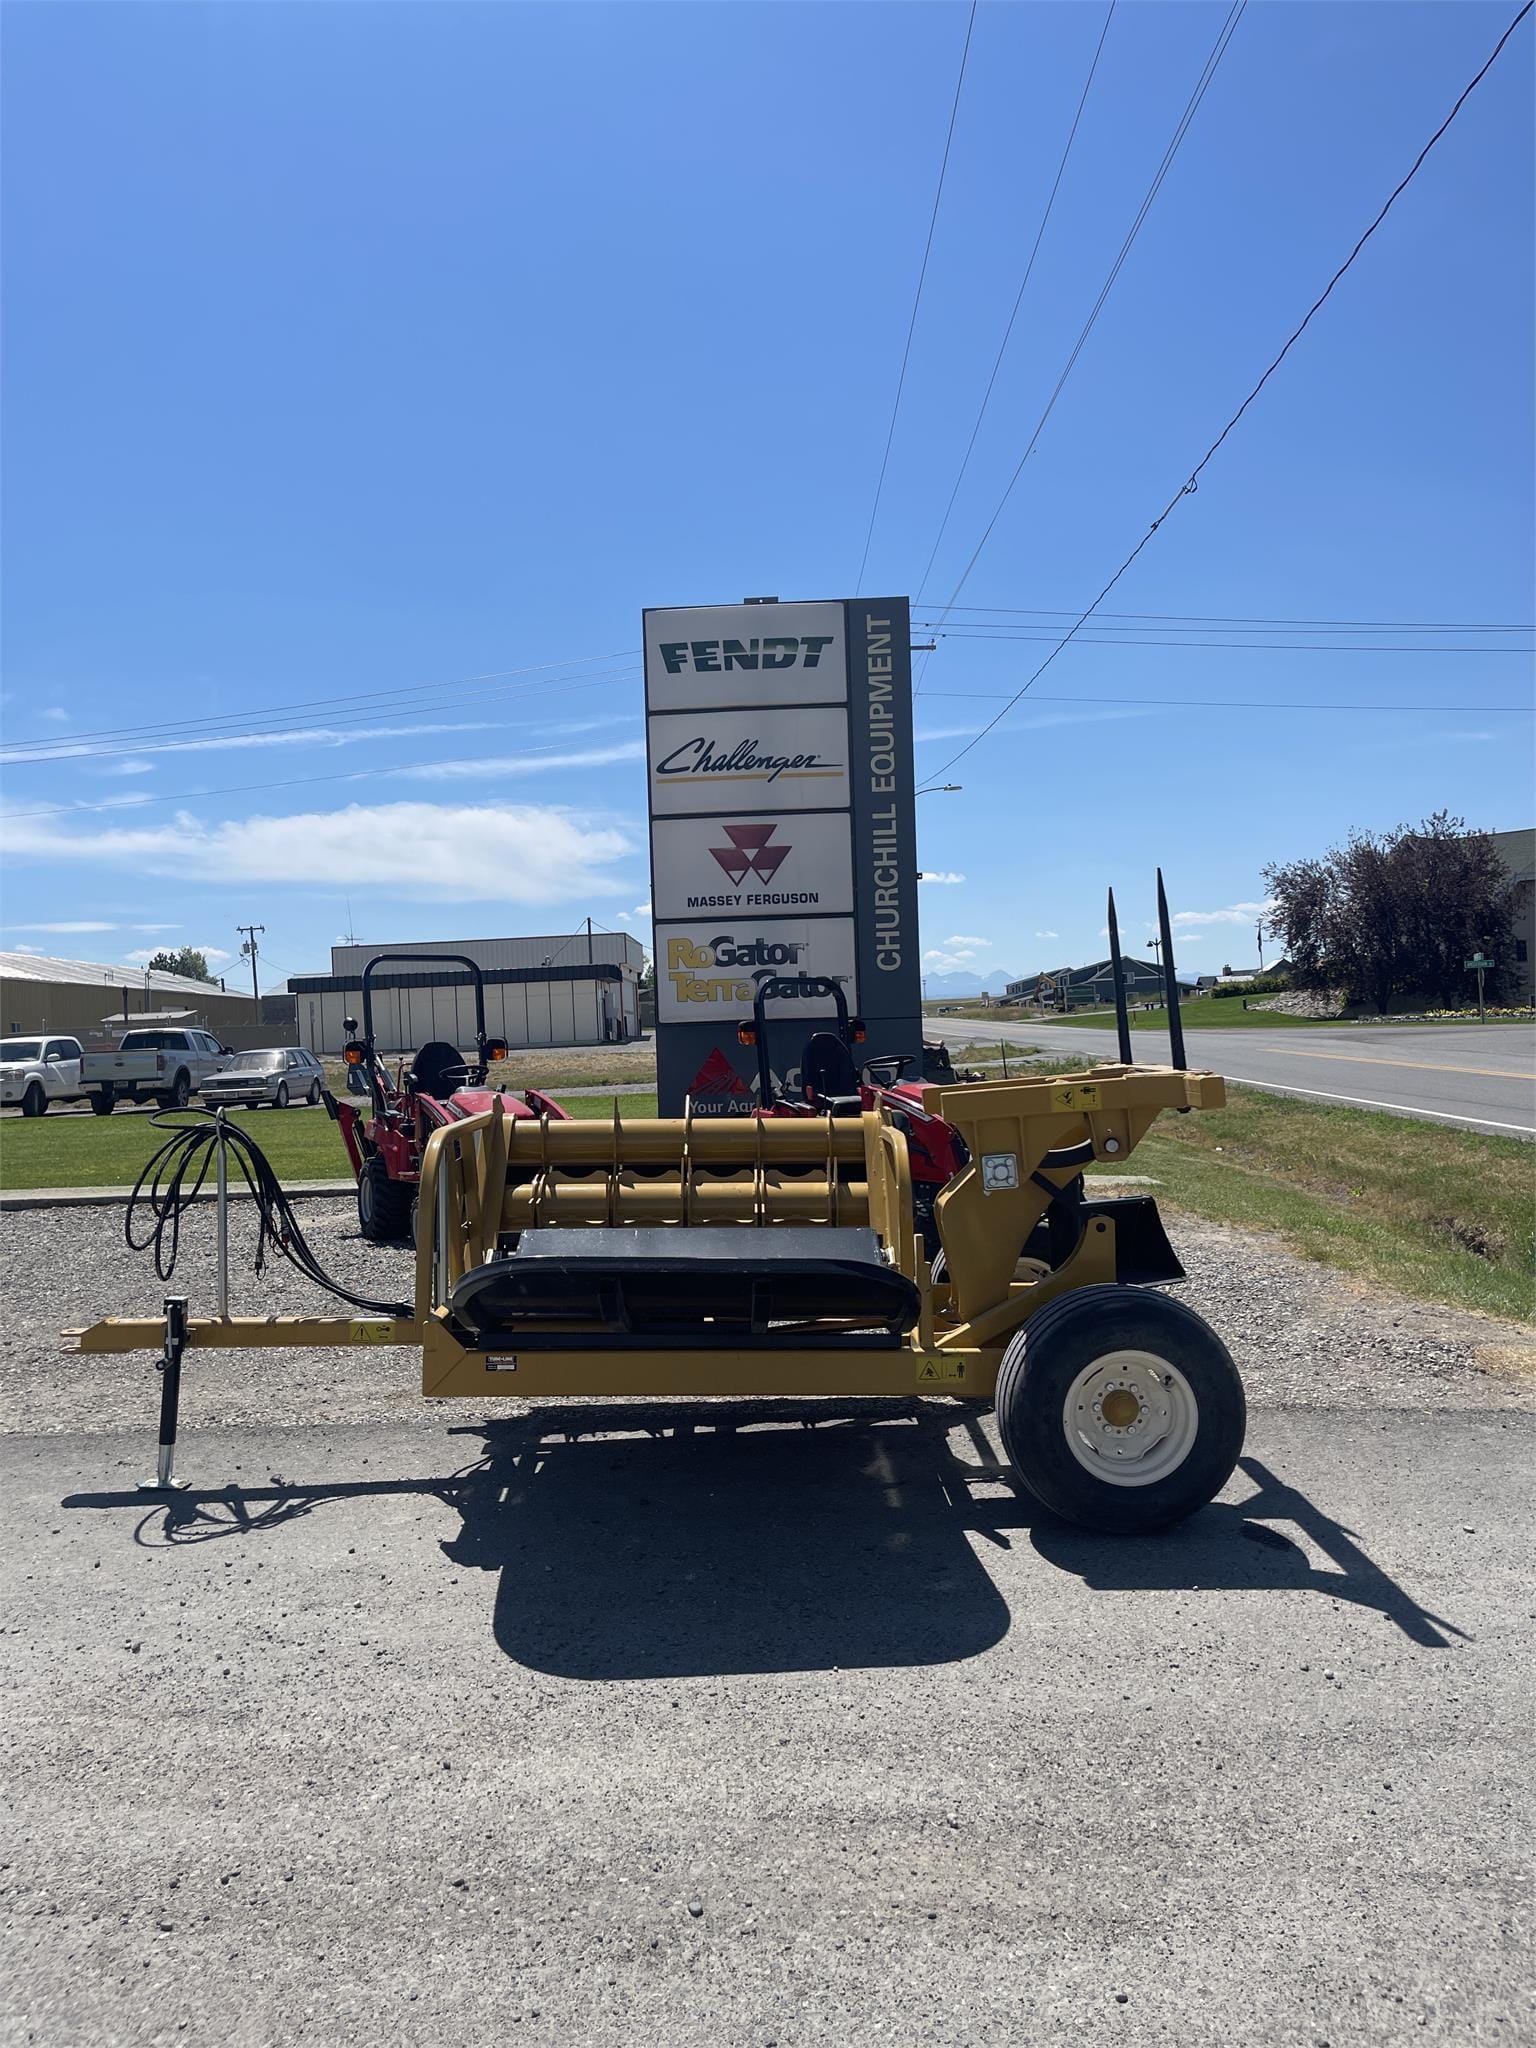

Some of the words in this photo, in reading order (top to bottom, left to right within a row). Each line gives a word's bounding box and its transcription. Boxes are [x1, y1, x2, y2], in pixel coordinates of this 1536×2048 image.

[658, 636, 834, 674] FENDT
[866, 614, 896, 792] EQUIPMENT
[656, 736, 844, 783] Challenger
[687, 894, 742, 908] MASSEY
[746, 892, 819, 906] FERGUSON
[872, 803, 900, 971] CHURCHILL
[667, 935, 805, 969] RoGator
[690, 1100, 724, 1114] Your
